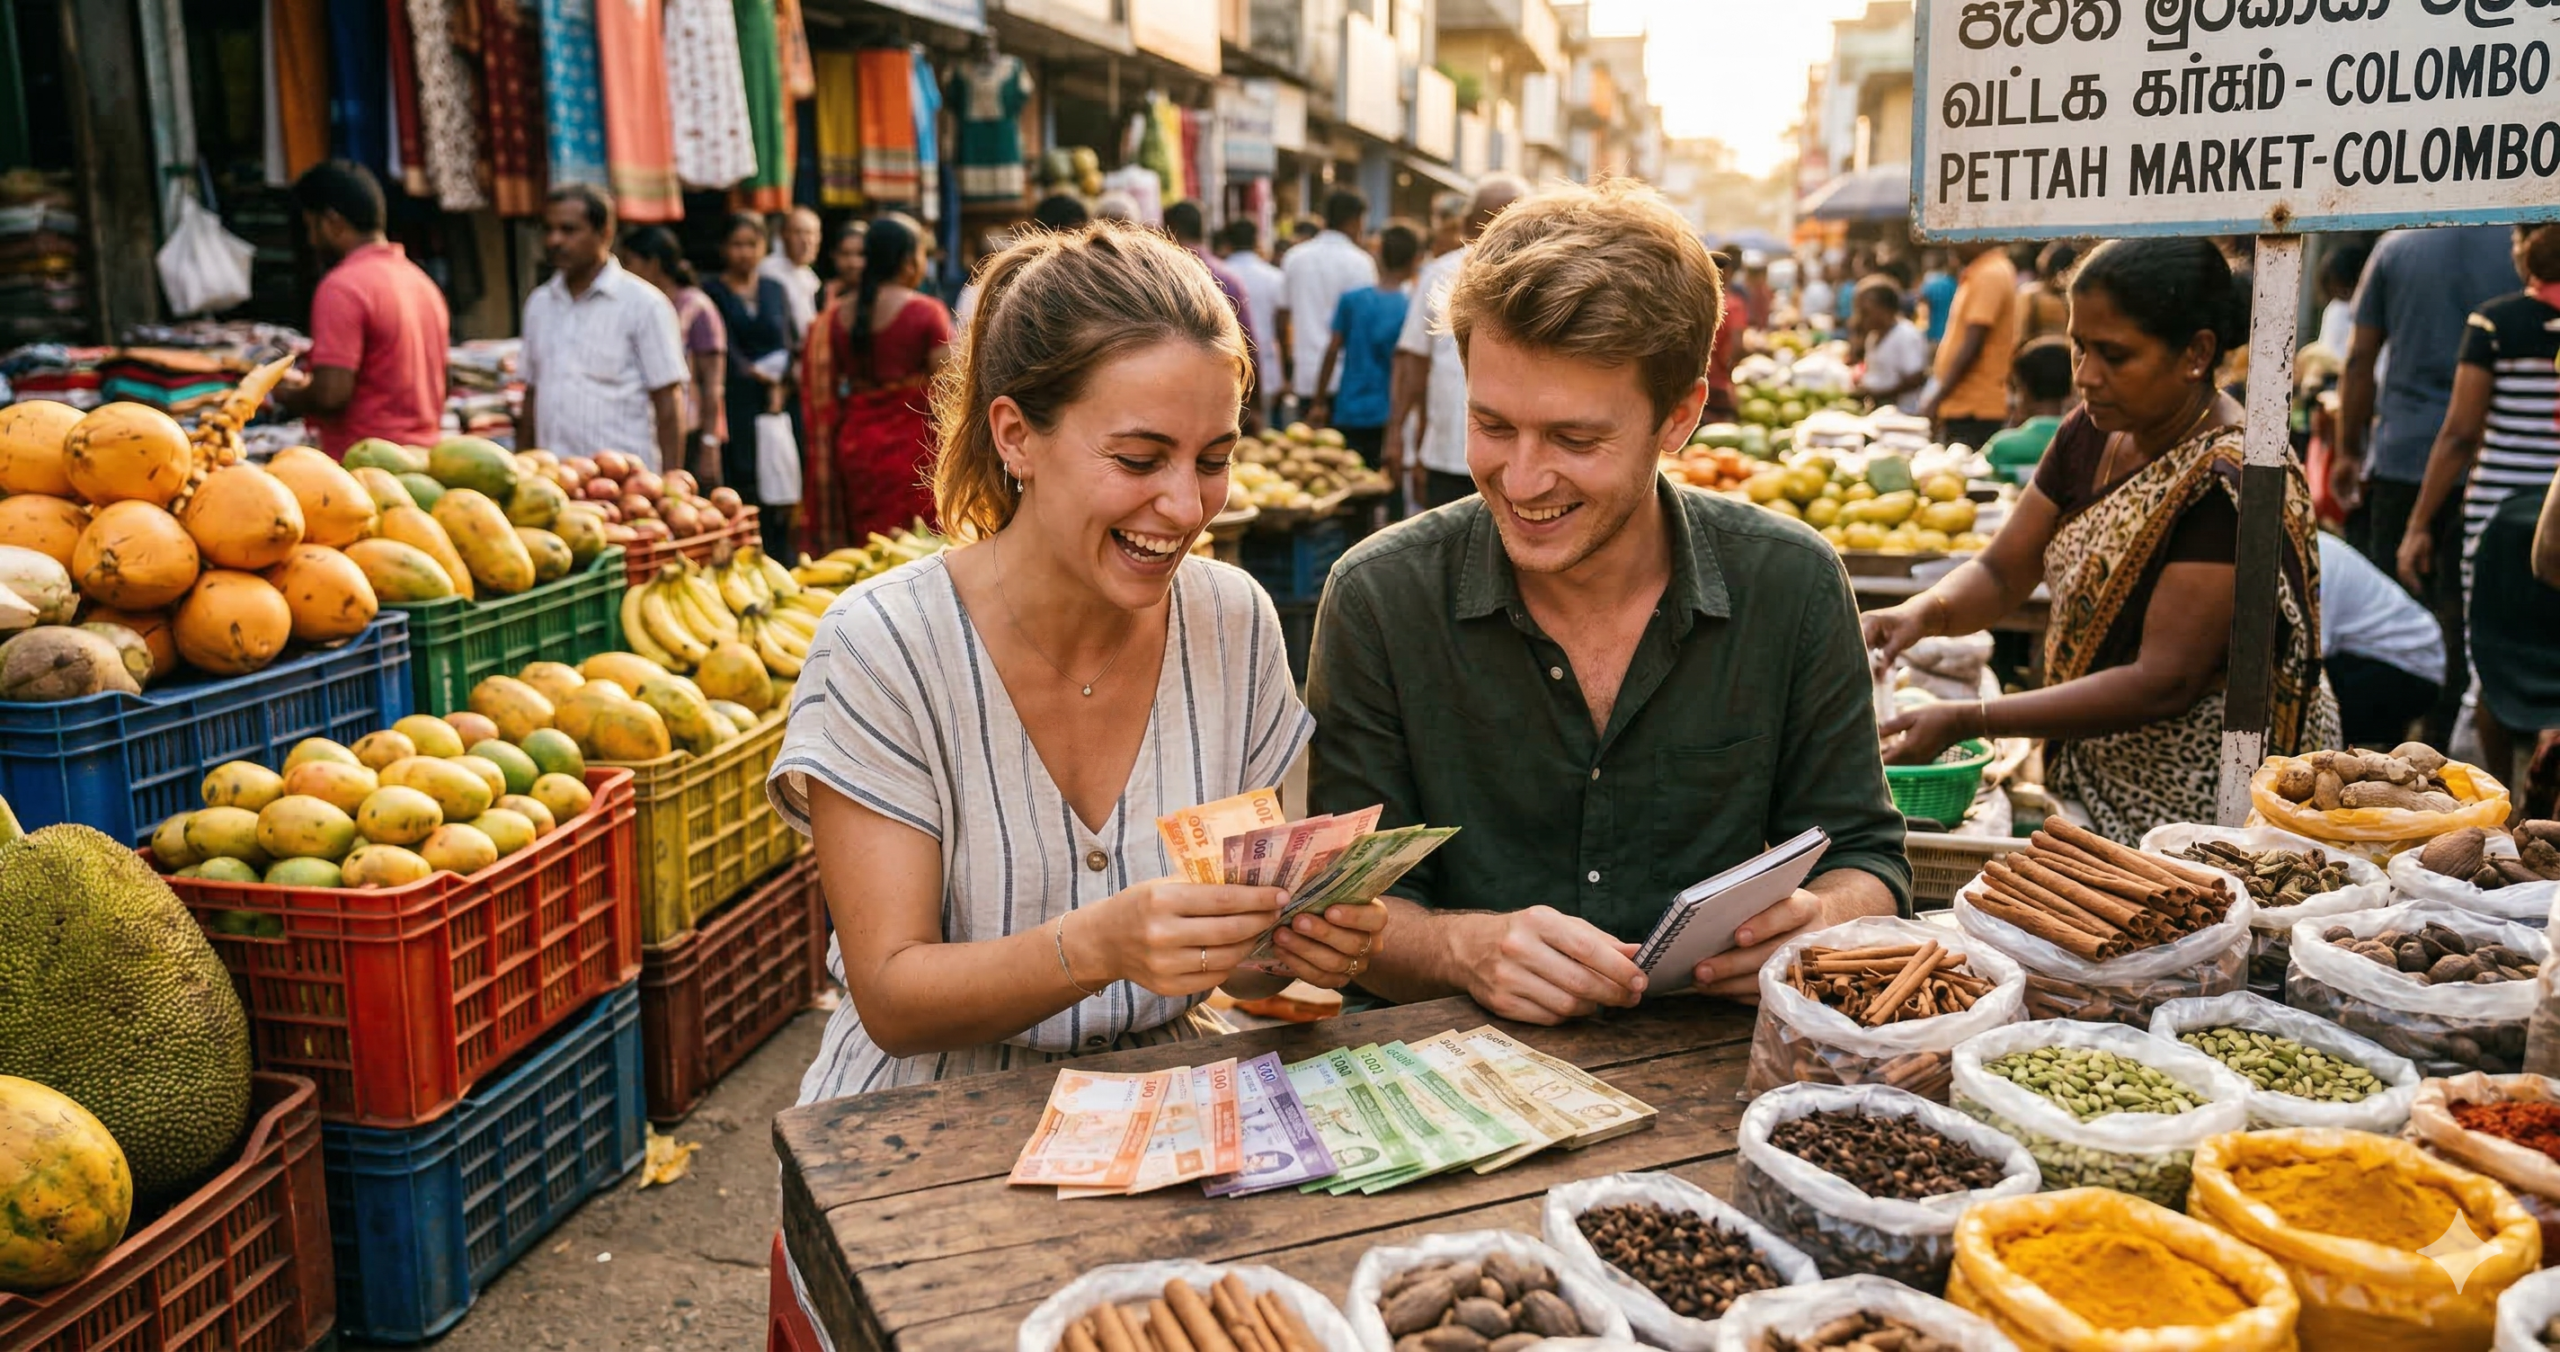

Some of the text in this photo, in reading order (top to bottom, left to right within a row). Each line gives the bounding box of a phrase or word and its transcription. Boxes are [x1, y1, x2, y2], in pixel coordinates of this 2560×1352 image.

[2326, 40, 2550, 106] COLOMBO
[1939, 121, 2560, 203] PETTAH MARKET-COLOMBO
[1213, 1068, 1228, 1090] 100
